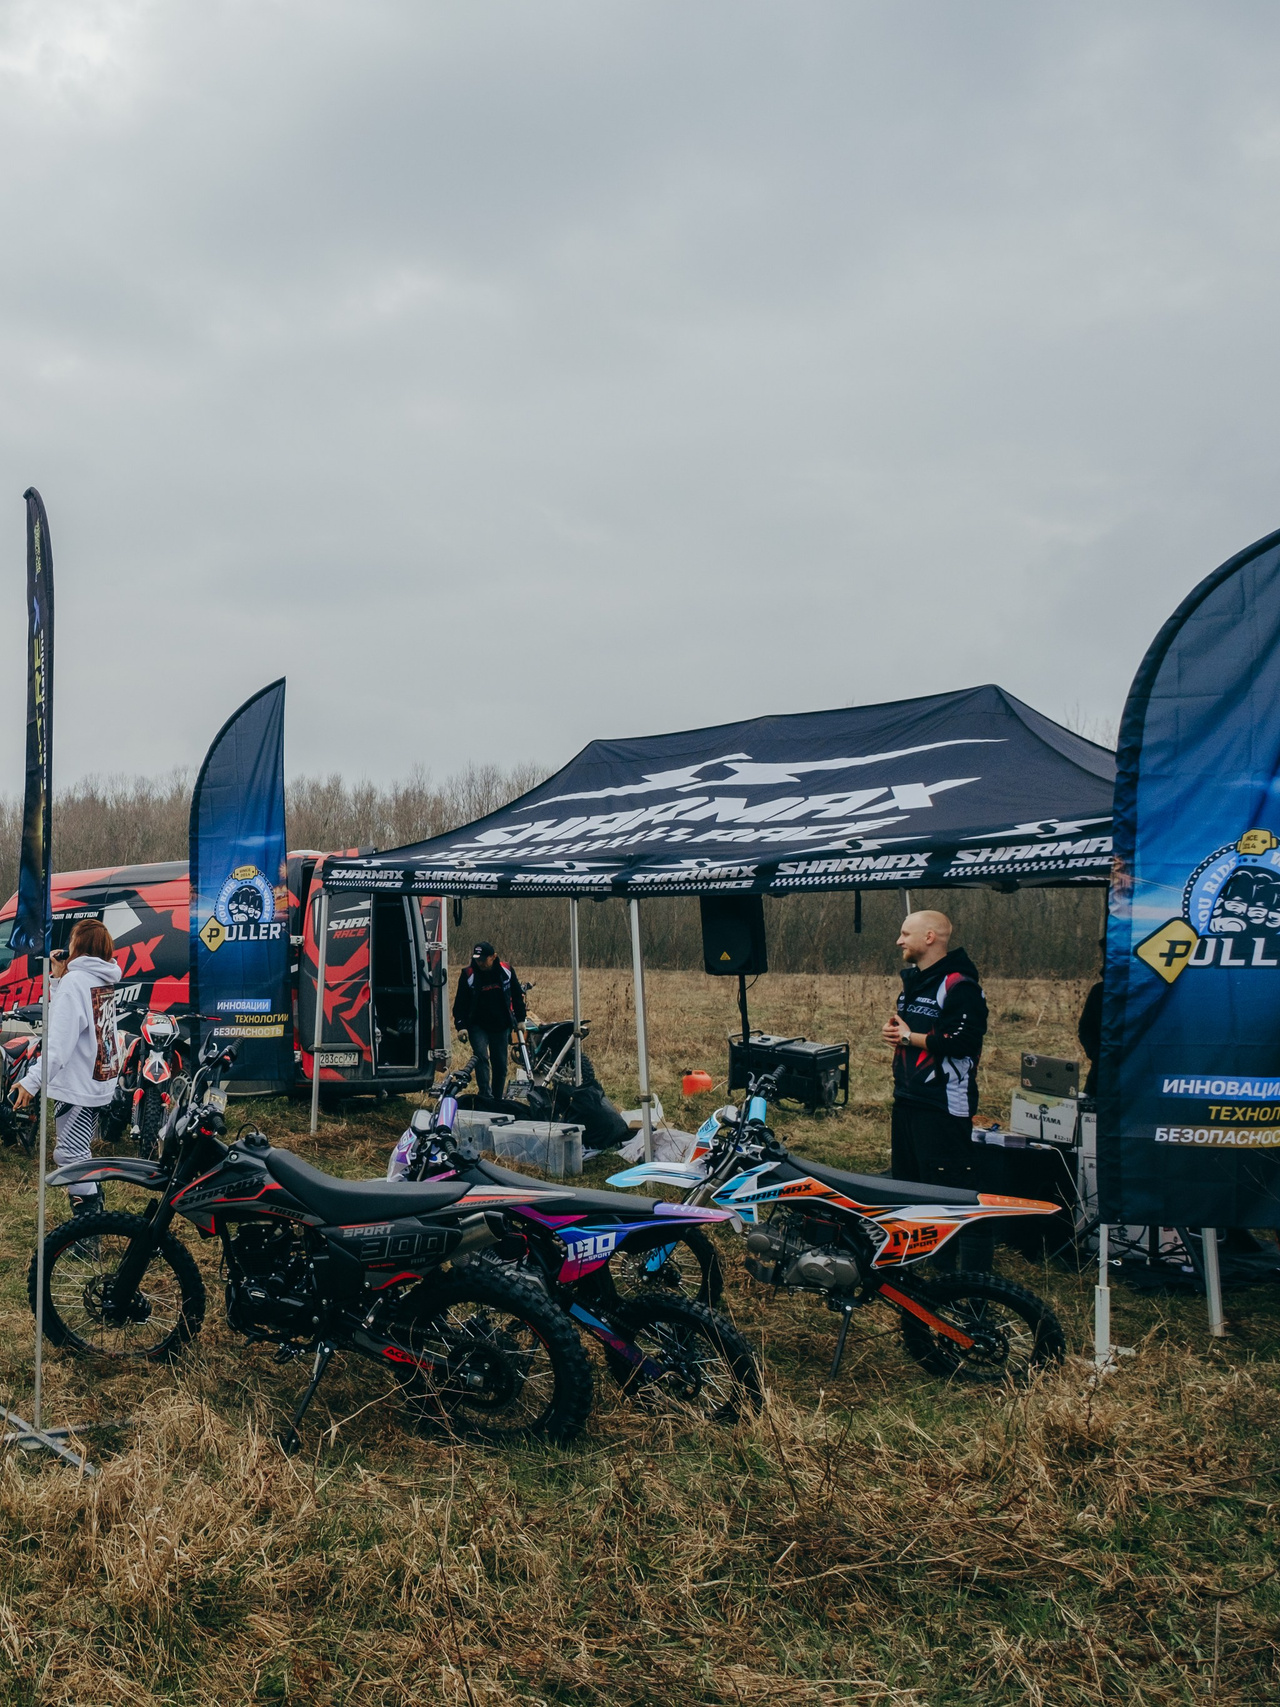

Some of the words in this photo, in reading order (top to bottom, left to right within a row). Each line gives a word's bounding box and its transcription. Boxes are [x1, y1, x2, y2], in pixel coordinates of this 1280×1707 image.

[450, 777, 981, 848] SHARMAX
[951, 836, 1113, 865] SHARMA
[775, 852, 933, 876] SHARMAX
[1066, 855, 1113, 869] RAC
[328, 869, 405, 880] SHARMAX
[414, 870, 504, 883] SHARMAX
[510, 873, 618, 884] SHARMAX
[628, 864, 759, 884] SHARMAX
[868, 870, 924, 881] RACE
[220, 881, 237, 903] RIDE
[468, 883, 498, 891] RACE
[709, 880, 755, 890] RACE
[263, 890, 271, 920] WORK
[73, 911, 99, 919] MOTION
[218, 905, 228, 923] YOU
[207, 923, 281, 943] PULLER
[333, 928, 367, 939] RACE
[1159, 938, 1279, 967] PULL
[217, 1001, 269, 1011] ИННОВАЦИИ
[235, 1013, 289, 1024] ТЕХНОЛОГИИ
[213, 1027, 282, 1036] БЕЗОПАСНОСТЬ
[320, 1054, 343, 1064] 283CC
[344, 1053, 357, 1062] 797
[1162, 1079, 1280, 1099] ИННОВАЦИ
[1208, 1105, 1280, 1120] ТЕХНОЛ
[1154, 1128, 1280, 1145] БЕЗОПАСНОС
[176, 1175, 267, 1207] SHARMAX
[732, 1182, 813, 1204] SHARMAX
[342, 1224, 395, 1238] SPORT
[360, 1231, 448, 1262] 300
[908, 1239, 939, 1250] SPORT
[588, 1251, 612, 1261] SPORT
